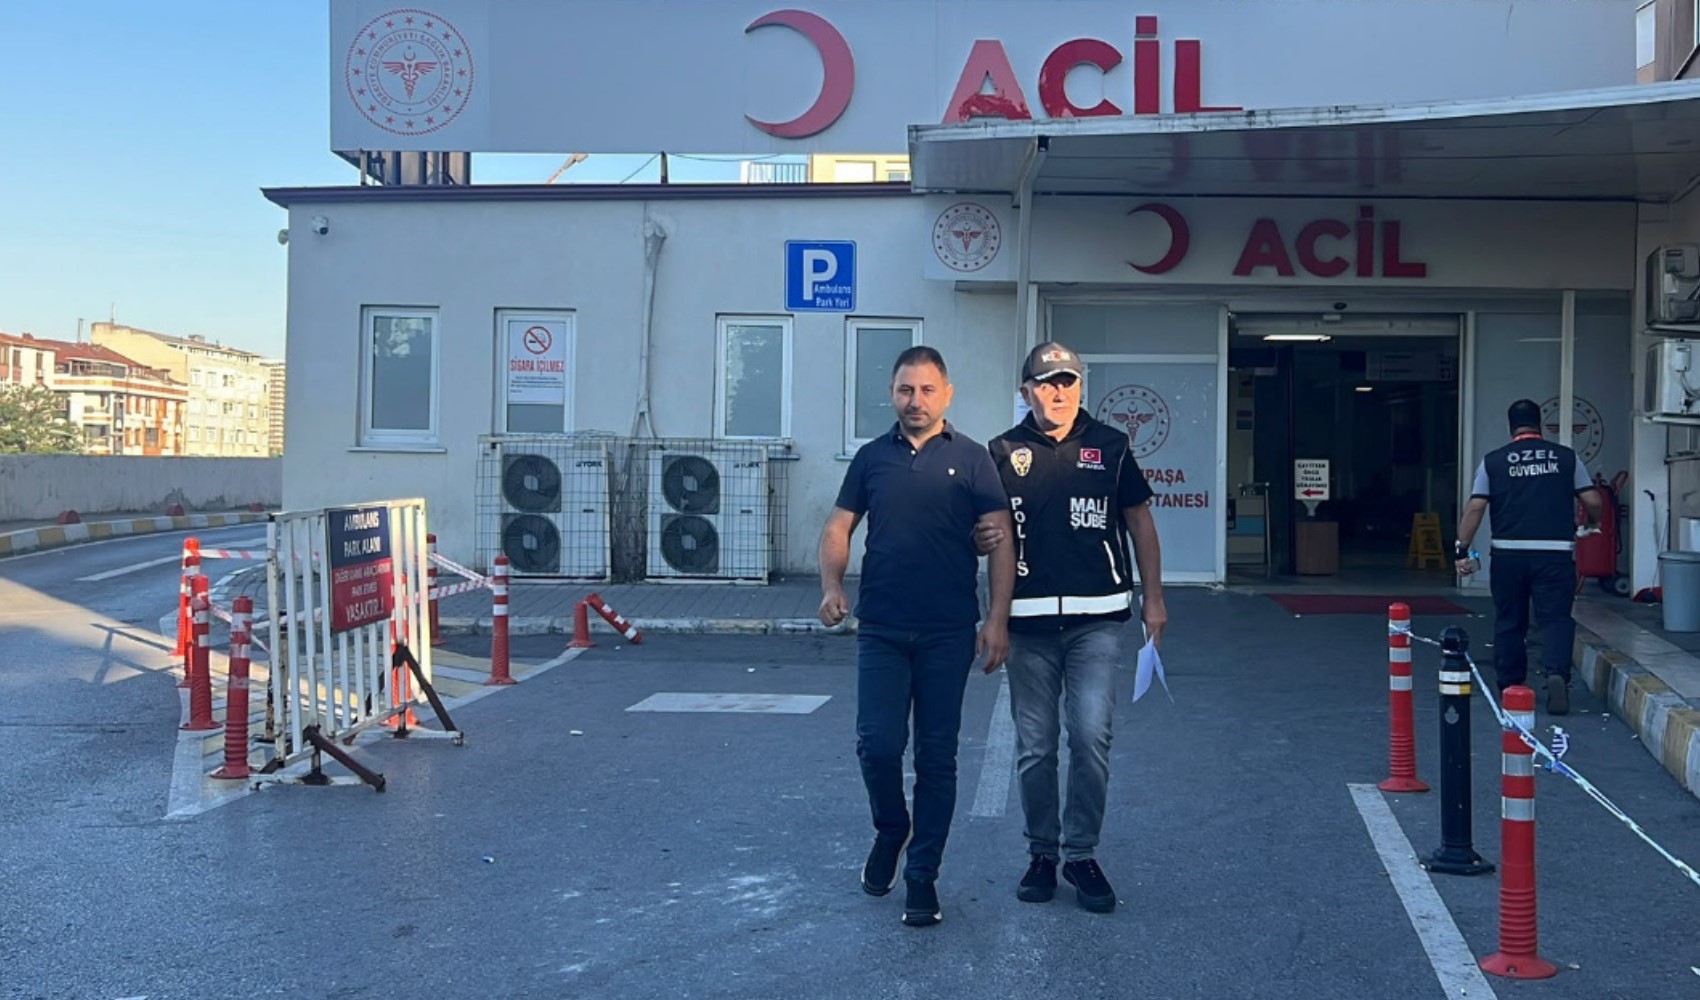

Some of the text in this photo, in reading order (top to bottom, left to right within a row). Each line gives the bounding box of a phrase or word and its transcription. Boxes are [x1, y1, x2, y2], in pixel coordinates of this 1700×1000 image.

[942, 15, 1244, 124] ACİL
[1232, 205, 1427, 278] ACİL
[803, 249, 838, 300] P
[816, 297, 833, 307] Park
[510, 356, 565, 375] SİGARA İÇİLMEZ
[1507, 449, 1558, 463] ÖZEL
[1143, 468, 1185, 487] PAŞA
[1509, 460, 1559, 477] GÜVENLİK
[1069, 495, 1108, 514] MALİ
[344, 511, 379, 531] AMBULANS
[1070, 512, 1107, 531] ŞUBE
[344, 536, 381, 558] PARK ALANI
